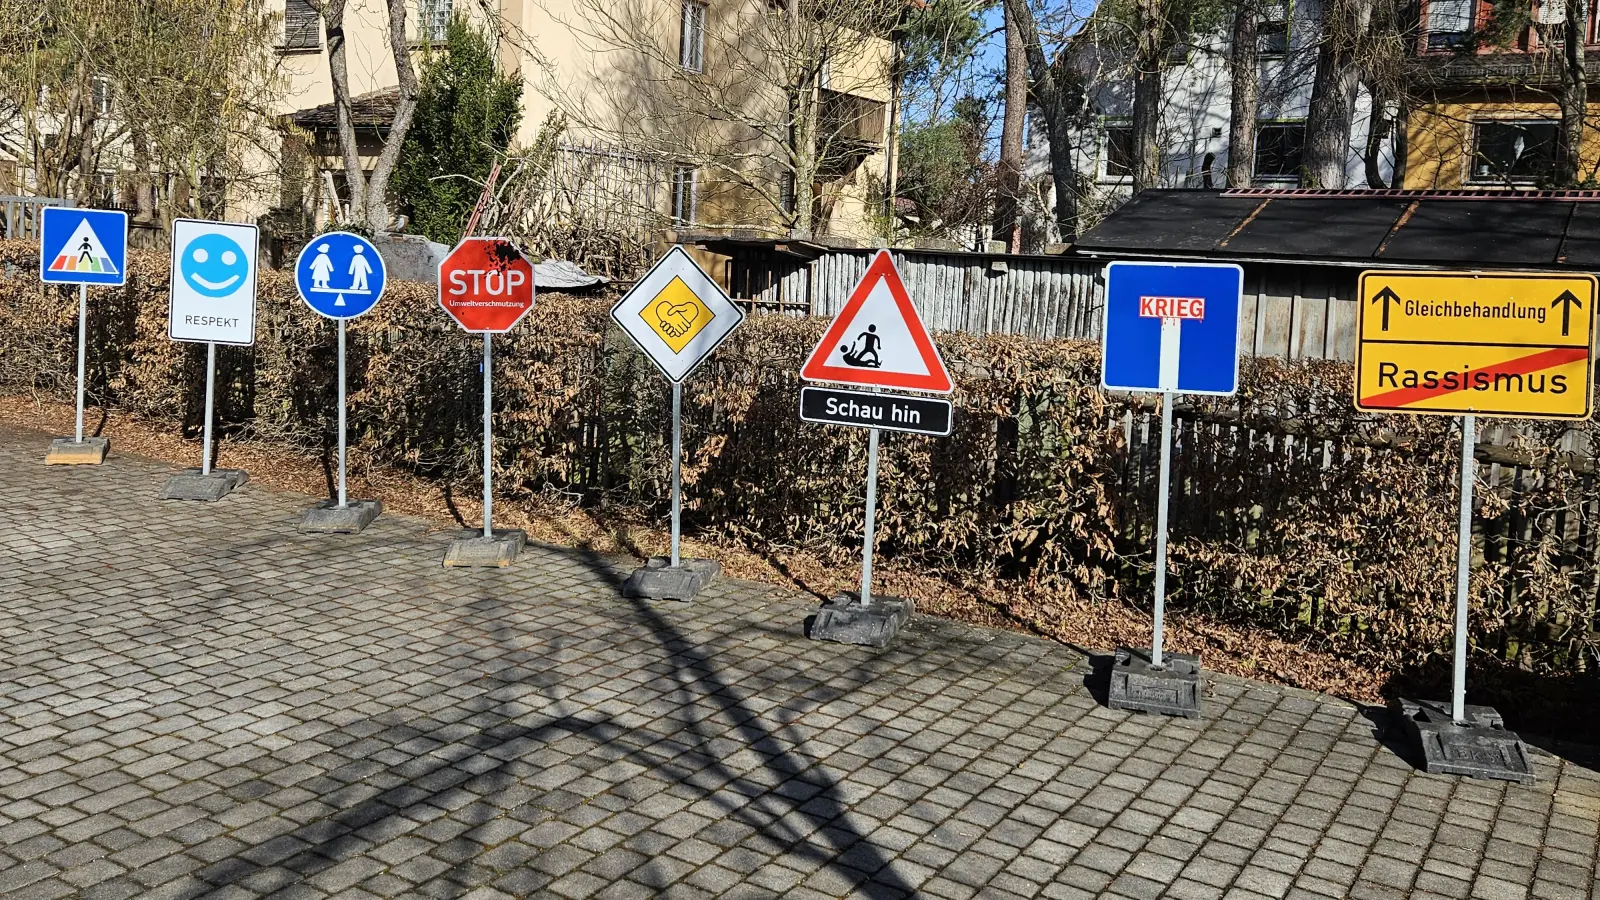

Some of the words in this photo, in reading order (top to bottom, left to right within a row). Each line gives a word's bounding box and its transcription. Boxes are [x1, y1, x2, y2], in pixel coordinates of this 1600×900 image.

[449, 270, 525, 296] STOP
[449, 300, 525, 308] Umweltverschmutzung
[1141, 298, 1203, 317] KRIEG
[1405, 300, 1546, 323] Gleichbehandlung
[185, 315, 239, 328] RESPEKT
[1378, 362, 1567, 394] Rassismus
[825, 398, 883, 420] Schau
[892, 404, 921, 424] hin
